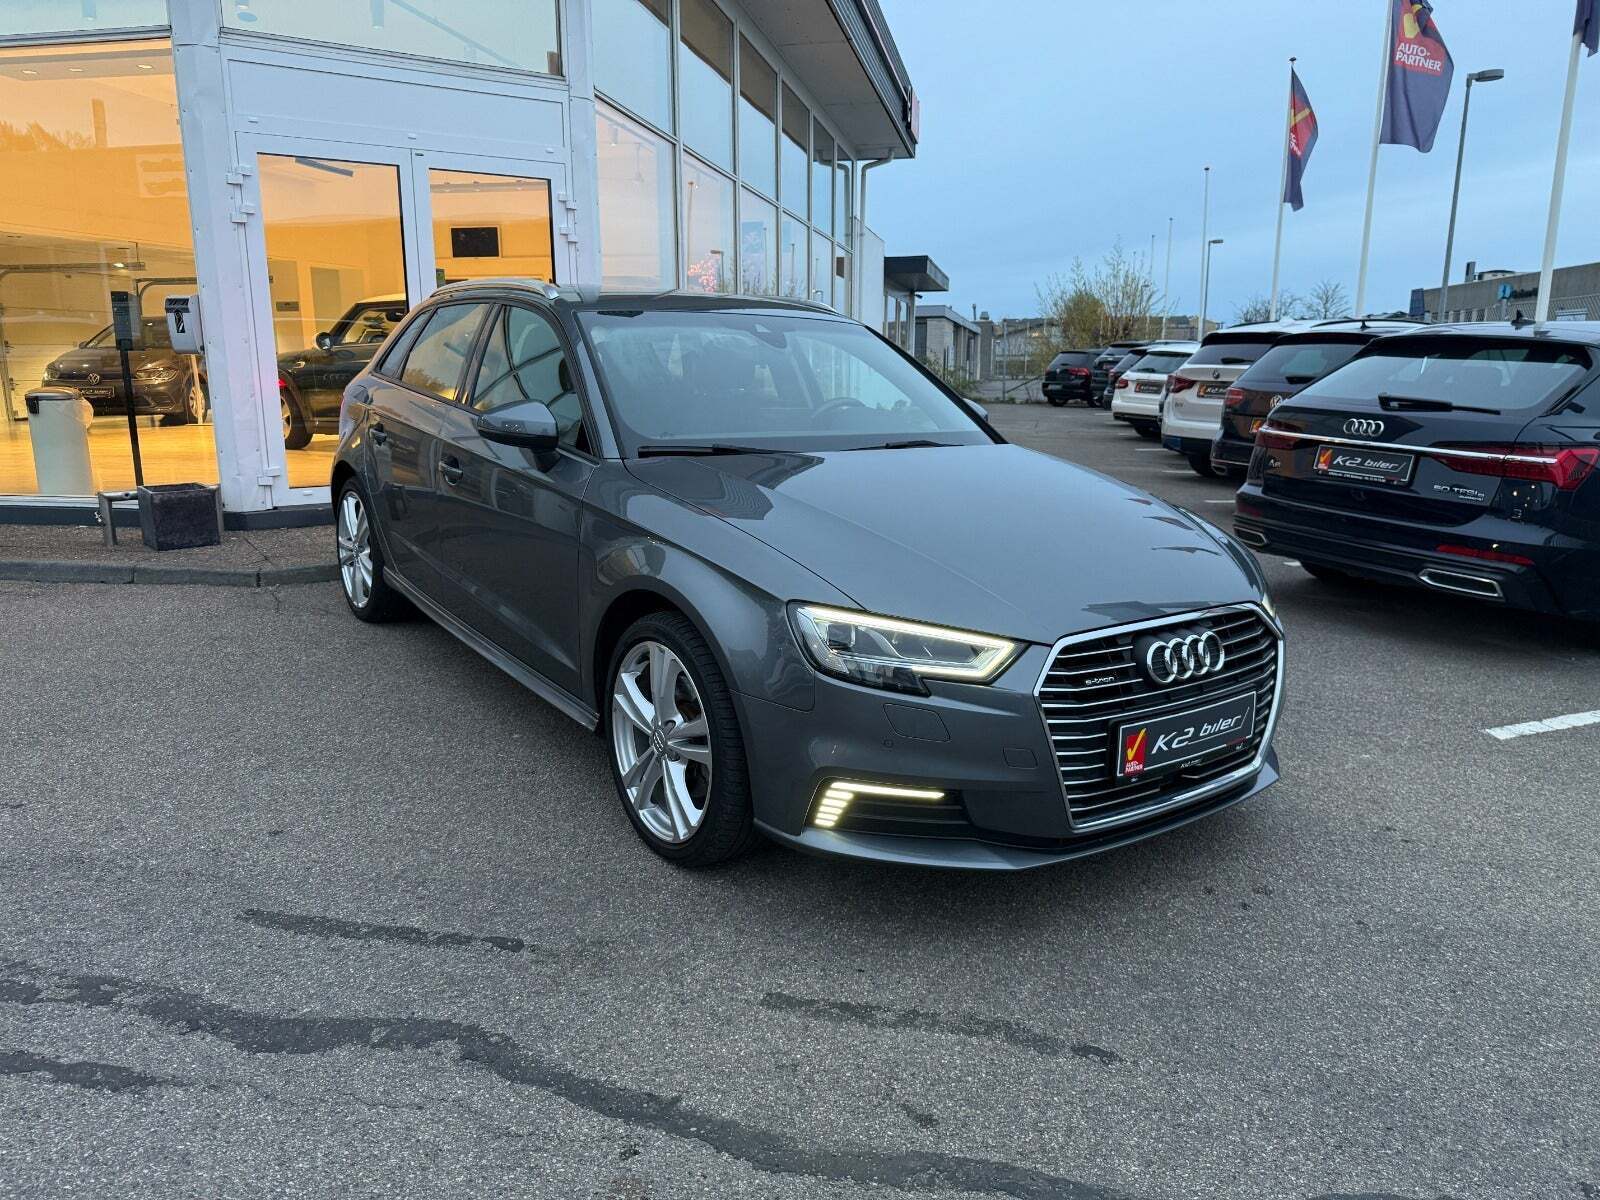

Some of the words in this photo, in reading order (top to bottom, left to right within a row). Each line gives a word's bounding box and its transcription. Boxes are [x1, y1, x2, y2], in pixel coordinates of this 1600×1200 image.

[1397, 42, 1431, 57] AUTO-
[1395, 52, 1442, 71] PARTNER
[1332, 455, 1361, 467] K2
[1363, 458, 1399, 470] biler
[1151, 727, 1195, 755] K2
[1199, 714, 1242, 737] biler
